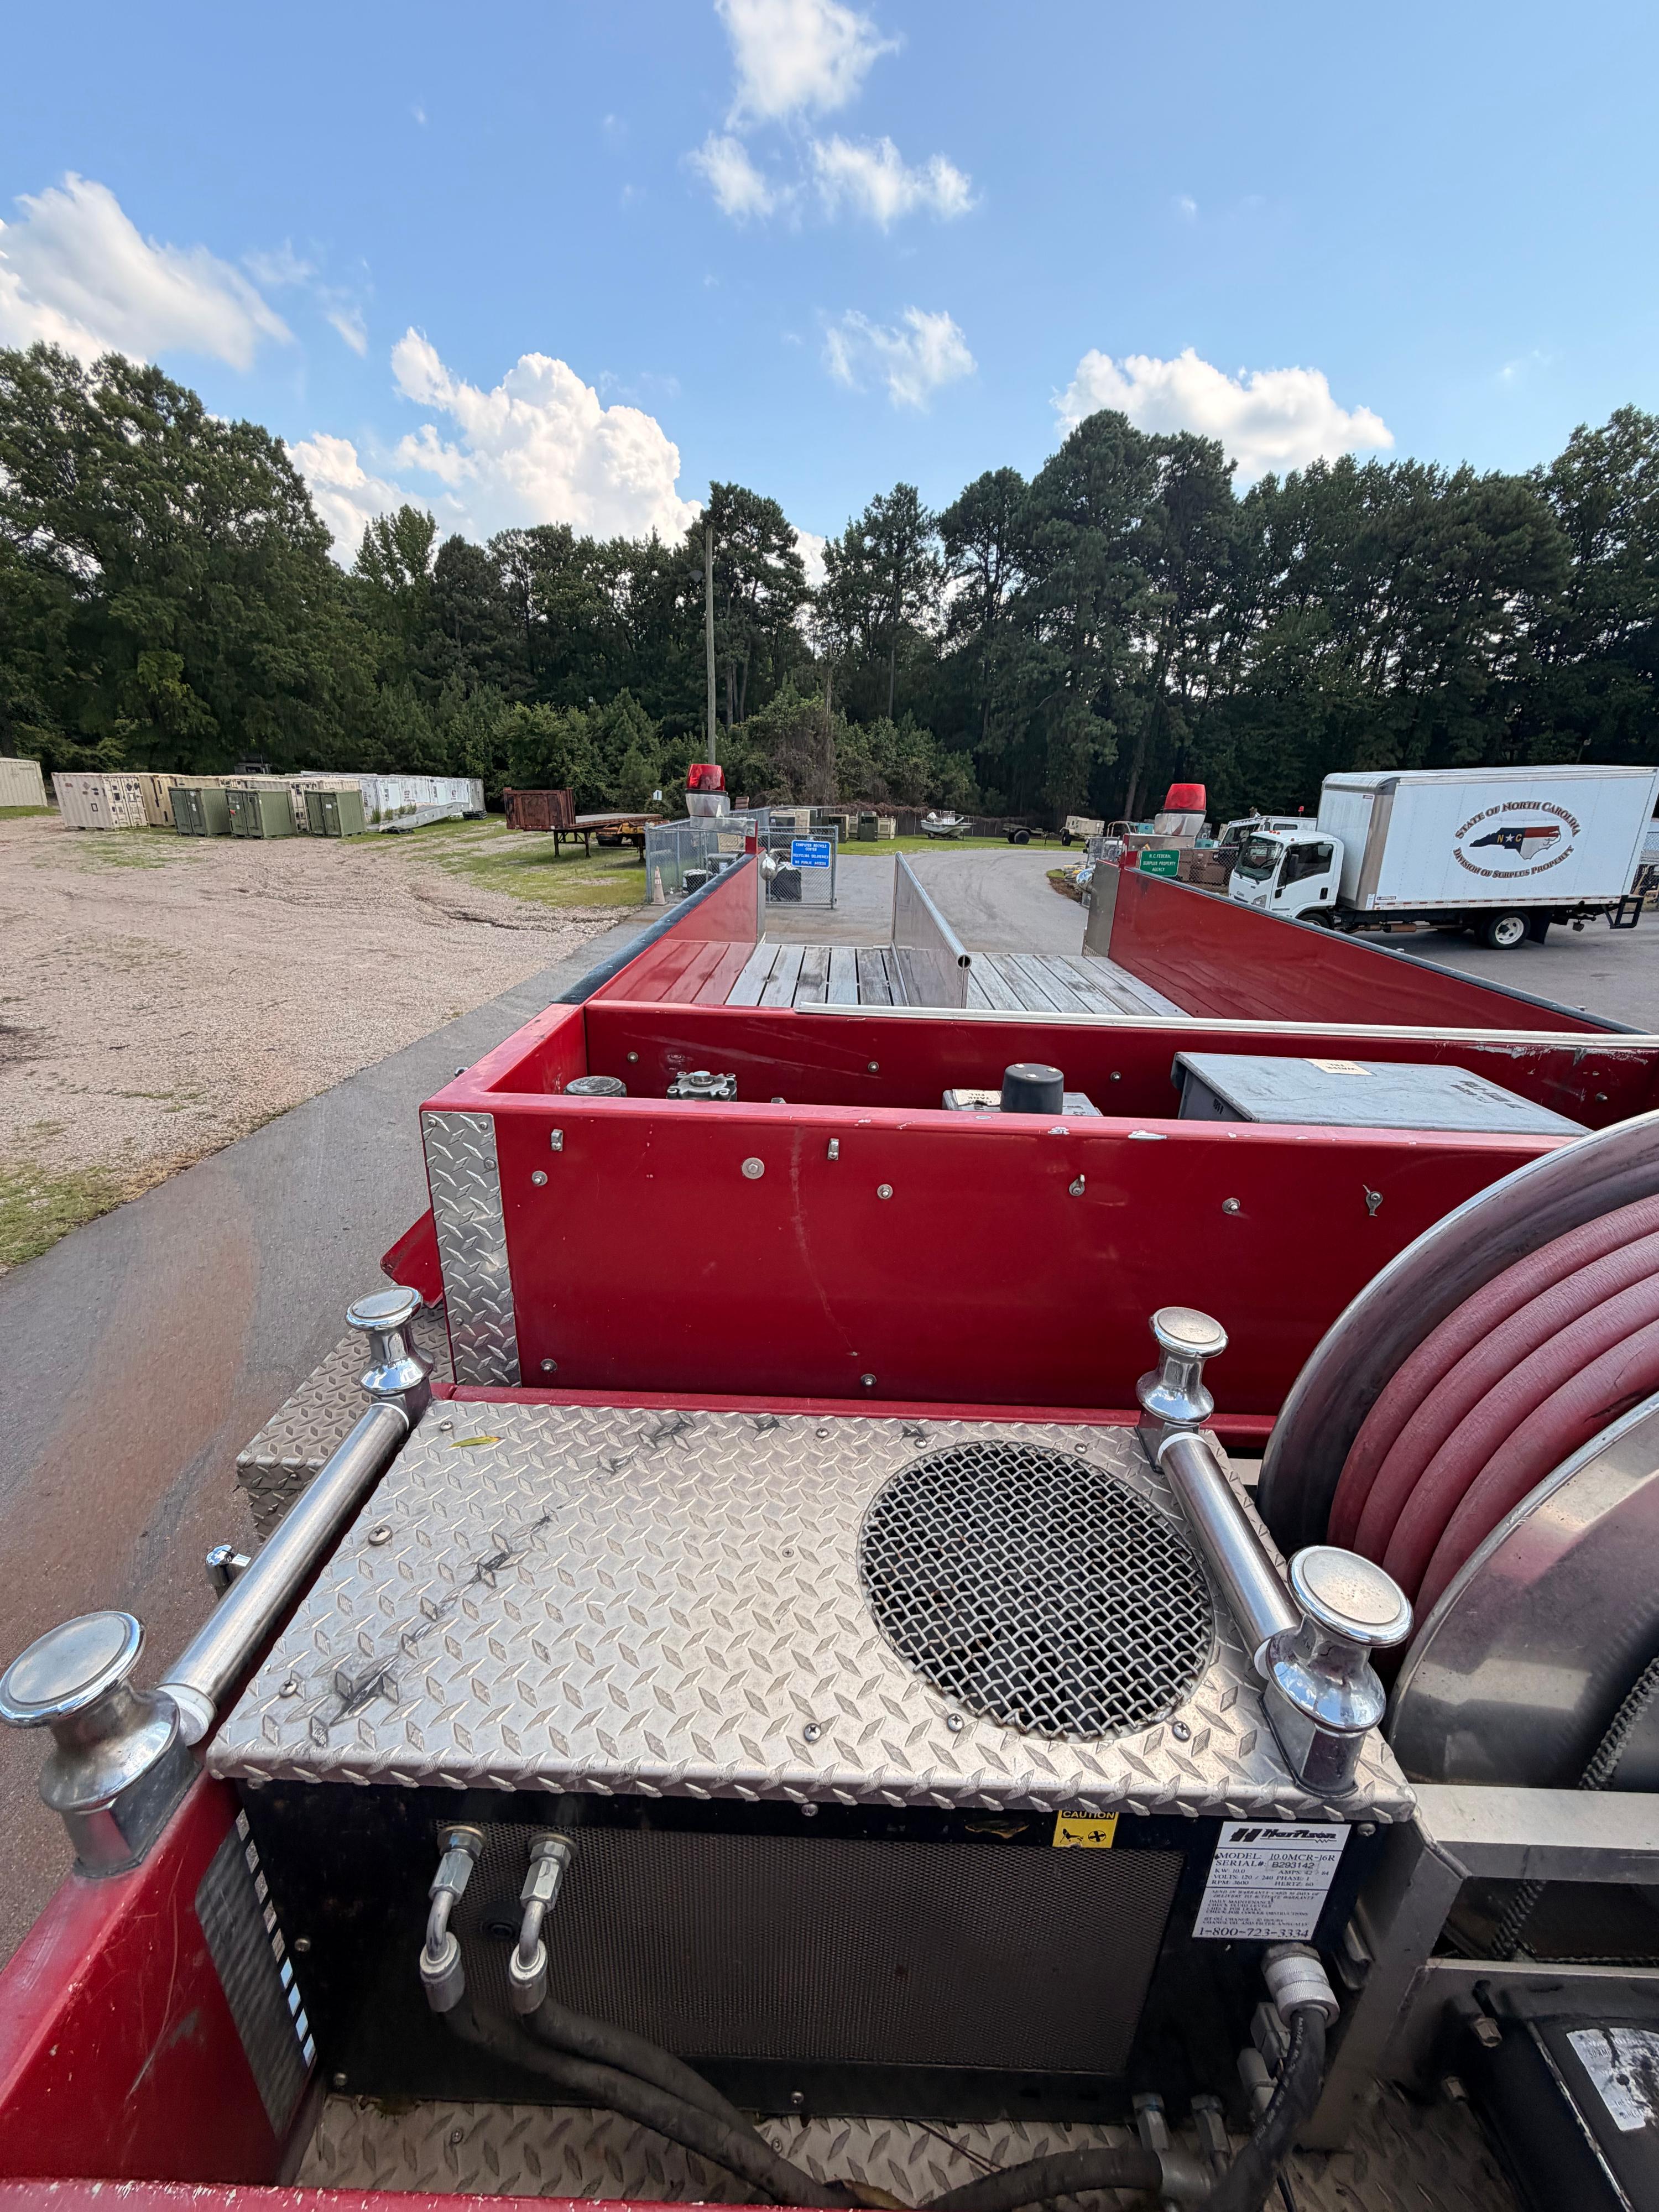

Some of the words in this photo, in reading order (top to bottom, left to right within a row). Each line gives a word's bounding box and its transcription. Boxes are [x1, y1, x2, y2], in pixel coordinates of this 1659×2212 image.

[1455, 811, 1485, 839] STATE
[1485, 804, 1500, 817] OF
[1501, 801, 1542, 812] NORTH
[1542, 802, 1581, 838] CAROLINA
[1497, 834, 1504, 843] N
[1515, 834, 1522, 842] C
[1453, 847, 1481, 875] DIVISION
[1480, 869, 1492, 878] OF
[1493, 869, 1530, 878] SURPLUS
[1531, 844, 1574, 875] PROPERTY
[1270, 1853, 1335, 1861] 10.0MCR-16R
[1199, 1927, 1308, 1938] 1-800-723-3334
